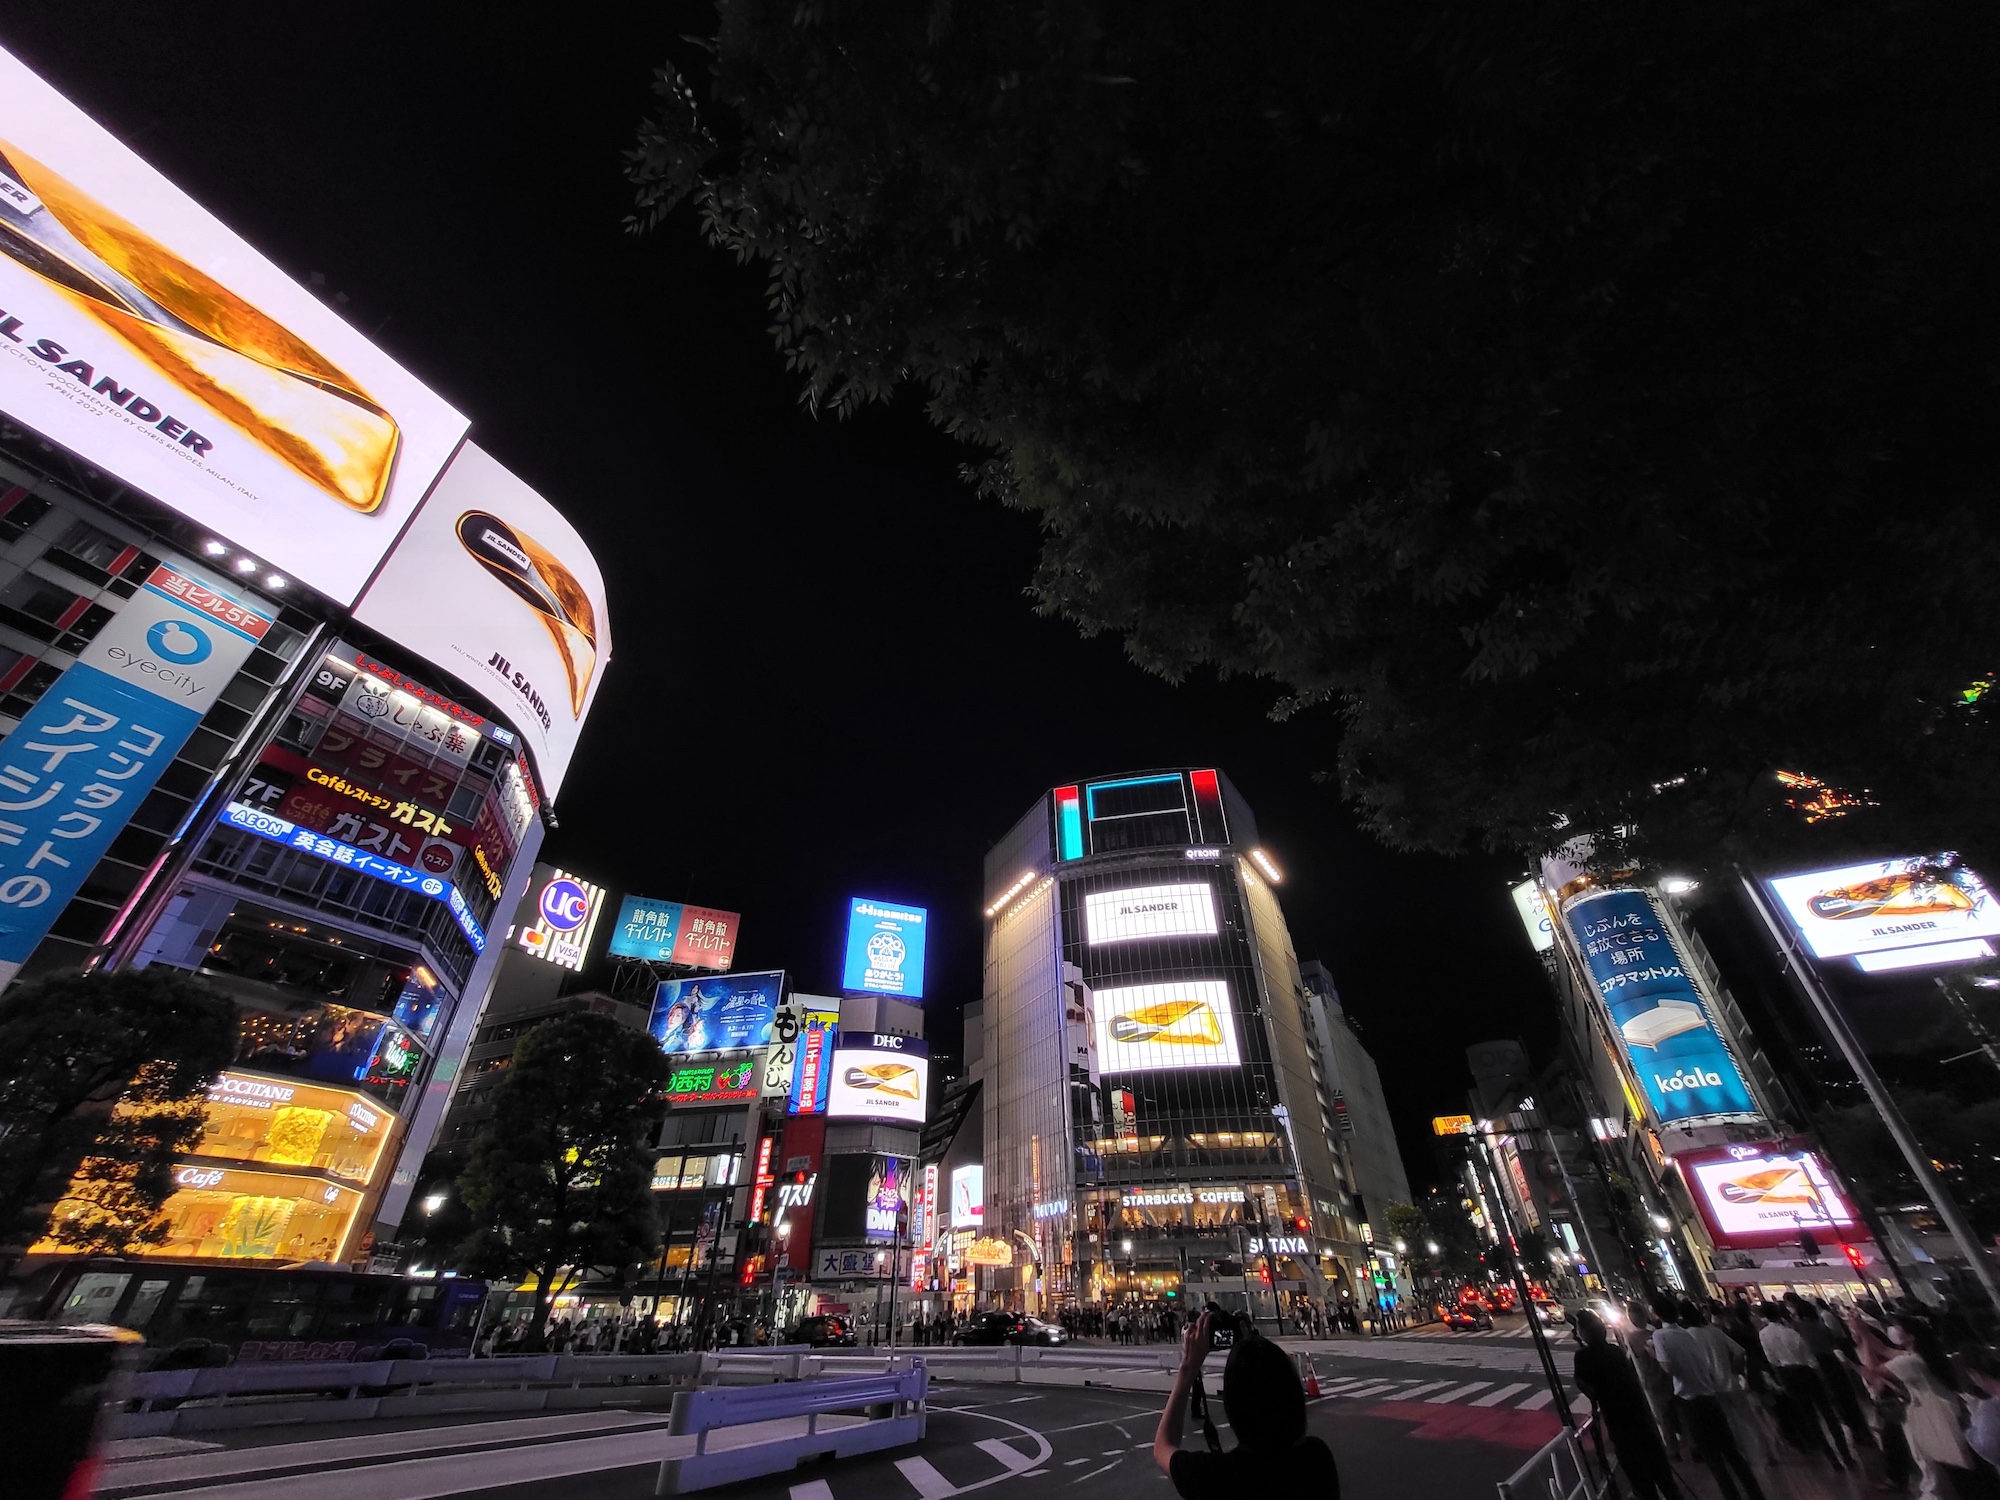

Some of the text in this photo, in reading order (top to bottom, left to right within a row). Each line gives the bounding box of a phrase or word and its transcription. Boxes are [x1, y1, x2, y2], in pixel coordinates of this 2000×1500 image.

[26, 338, 214, 458] SANDER
[46, 382, 104, 417] APRIL 2022
[48, 371, 122, 418] DOCUMENTED
[123, 418, 137, 426] BY
[137, 425, 164, 445] CHRIS
[166, 443, 204, 470] RHODES,
[237, 486, 259, 501] ITALY
[497, 540, 527, 564] SANDER
[107, 645, 206, 697] eyecity
[316, 670, 347, 691] 9F
[487, 651, 512, 680] JIL
[511, 671, 552, 735] SANDER
[393, 705, 467, 754] しゃぶ葉
[243, 777, 286, 804] 7F
[0, 724, 165, 908] コンタクトの
[290, 795, 330, 819] Café
[390, 800, 453, 837] ガスト
[326, 811, 412, 858] ガスト
[232, 810, 442, 894] AEON 英会話イーオン 6F
[424, 853, 449, 868] ガスト
[632, 908, 670, 928] 龍角散
[1120, 907, 1133, 915] JIL
[1134, 902, 1178, 914] SANDER
[624, 923, 672, 943] ダイレクト
[692, 917, 728, 937] 龍角散
[1583, 912, 1643, 937] じぶんを
[1871, 928, 1888, 936] JIL
[1888, 921, 1937, 934] SANDER
[558, 944, 579, 958] VISA
[685, 932, 730, 951] ダイレクト
[1586, 928, 1659, 958] 解放できる
[1610, 946, 1645, 966] 場所
[1600, 966, 1685, 993] コアラマットレス
[765, 1006, 799, 1094] もんじゃ
[873, 1034, 903, 1049] DHC
[800, 1033, 821, 1108] 三千里薬品
[1653, 1066, 1723, 1094] koala
[675, 1074, 713, 1093] 西村
[222, 1095, 272, 1109] PROVENCE
[875, 1099, 900, 1107] SANDER
[178, 1168, 225, 1188] Café
[926, 1171, 935, 1212] カラオケ
[1122, 1191, 1245, 1207] STARBUCKS COFFEE
[1769, 1210, 1800, 1219] SANDER
